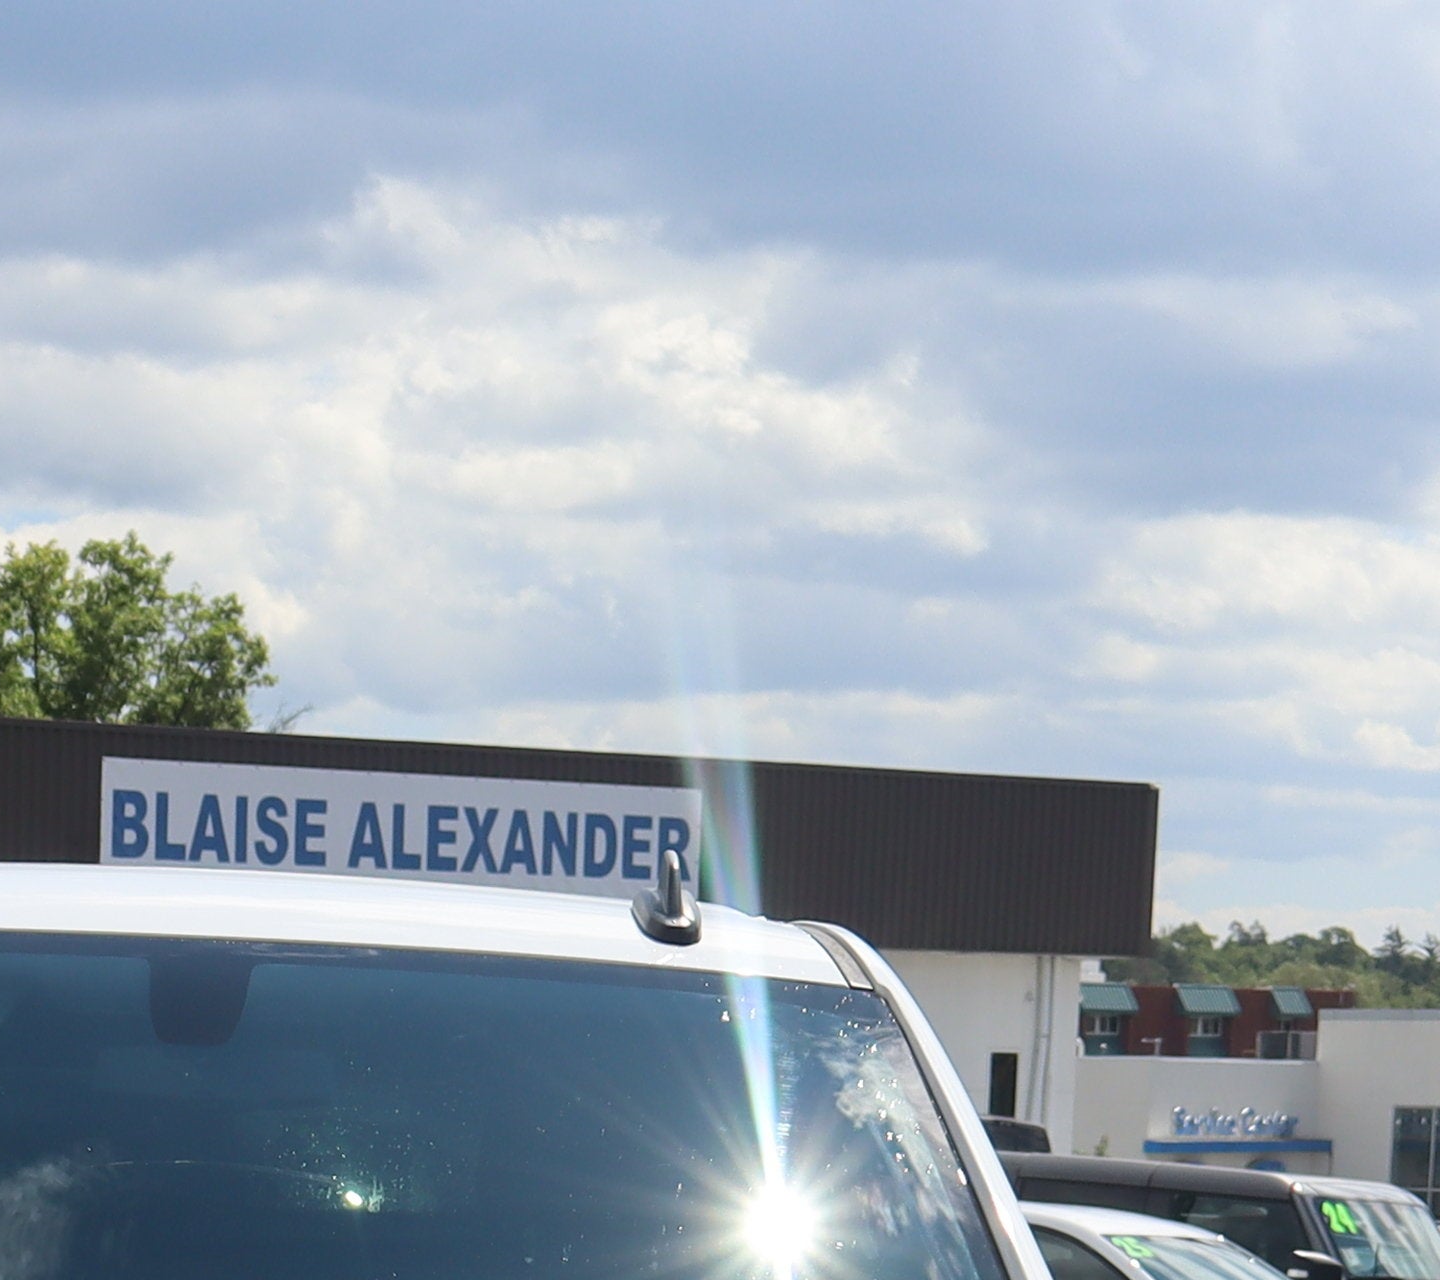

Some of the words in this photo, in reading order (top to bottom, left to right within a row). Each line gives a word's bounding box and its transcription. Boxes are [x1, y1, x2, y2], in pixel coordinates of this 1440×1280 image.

[111, 788, 328, 867] BLAISE
[347, 801, 691, 882] ALEXANDER
[1321, 1199, 1358, 1235] 24
